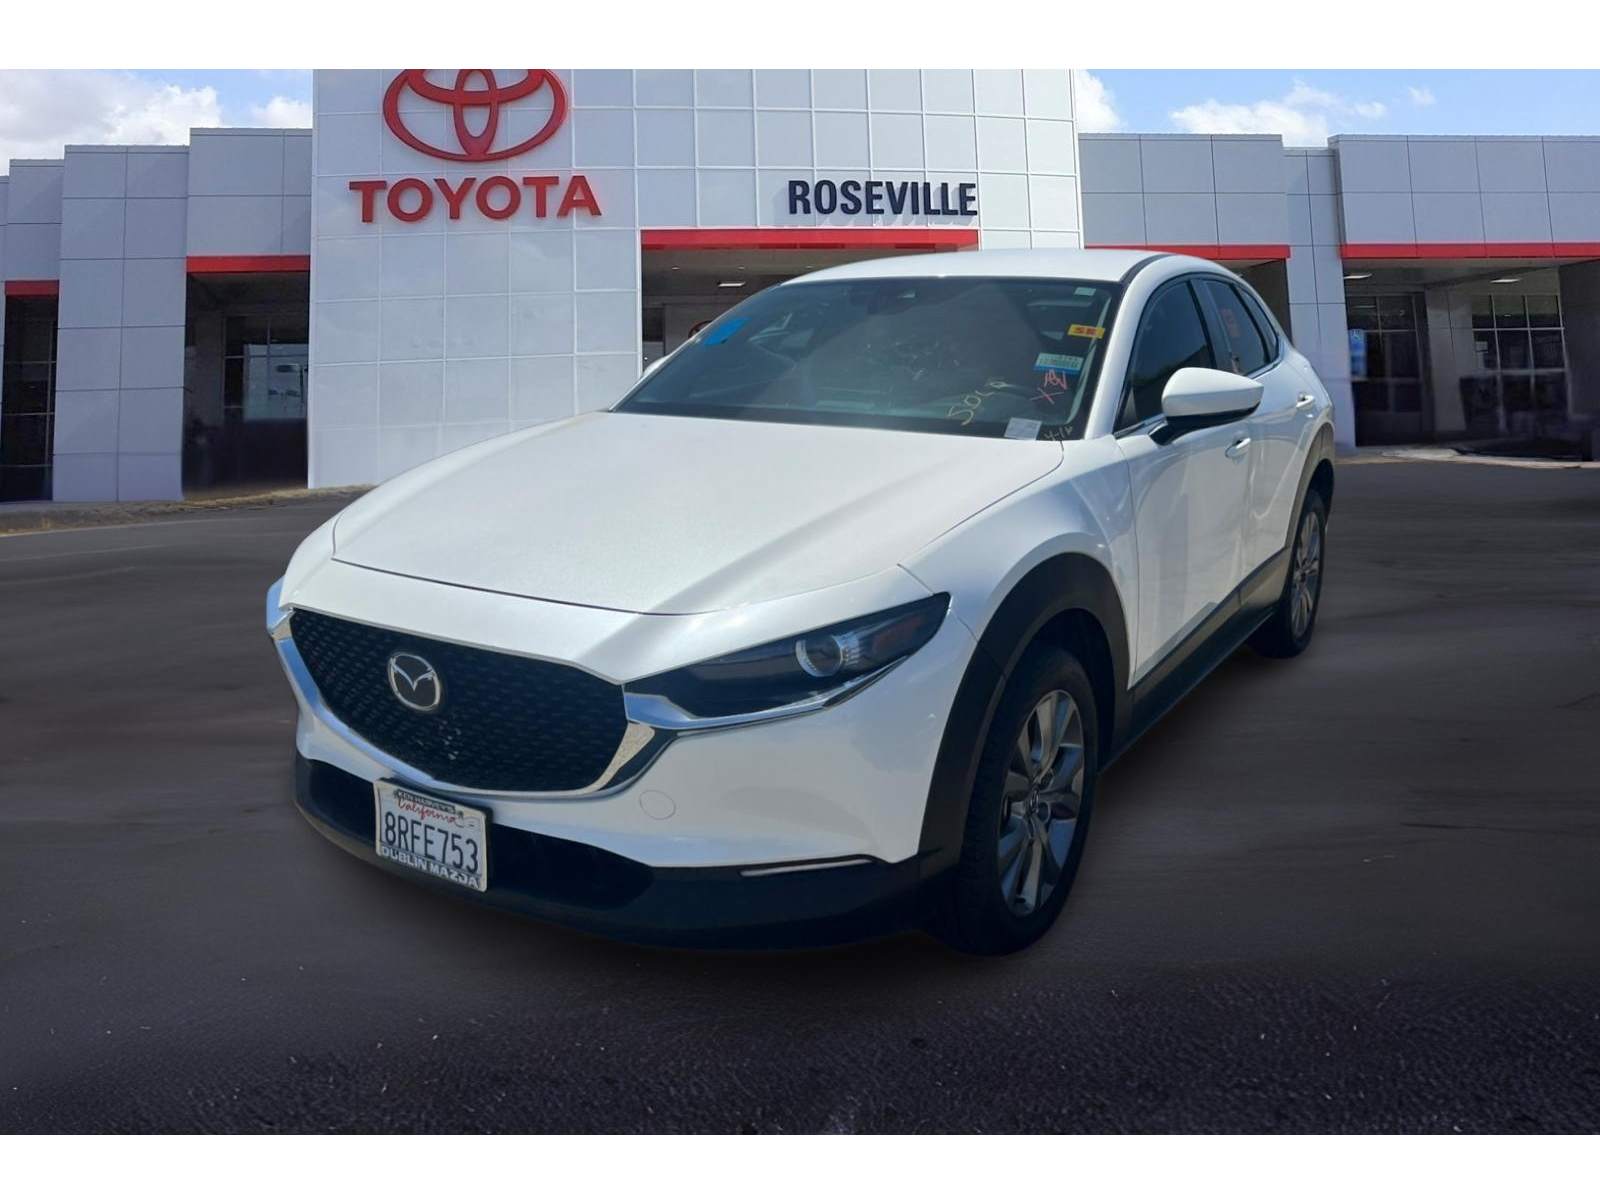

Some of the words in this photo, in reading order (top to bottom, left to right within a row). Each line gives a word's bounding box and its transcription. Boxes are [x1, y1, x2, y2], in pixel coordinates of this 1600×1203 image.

[349, 175, 602, 222] TOYOTA
[788, 179, 978, 216] ROSEVILLE
[382, 846, 427, 870] DUBLIN
[384, 811, 479, 874] 8RFE753
